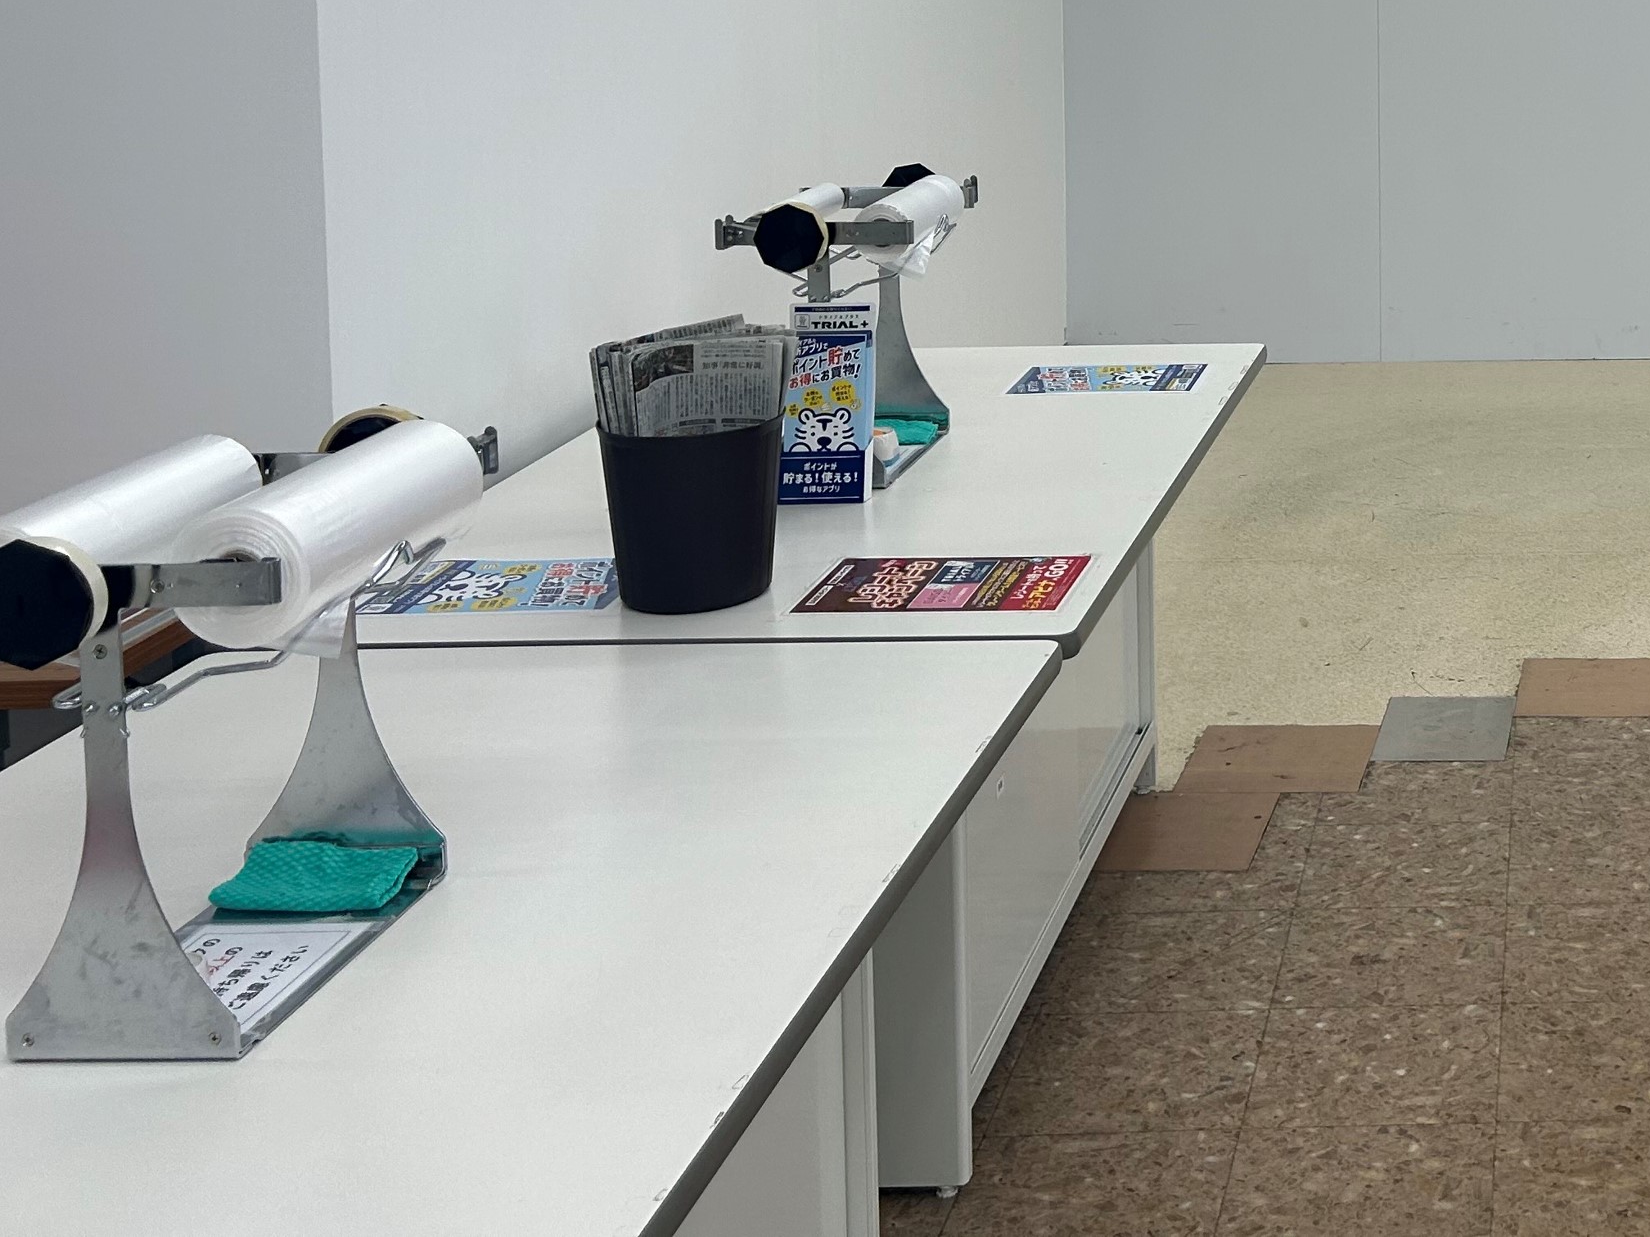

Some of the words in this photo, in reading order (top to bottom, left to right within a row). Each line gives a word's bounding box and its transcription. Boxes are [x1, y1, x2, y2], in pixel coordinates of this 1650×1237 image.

[789, 364, 860, 389] お得にお買物!
[803, 462, 837, 471] ポイントが
[803, 485, 840, 493] お得なアプリ
